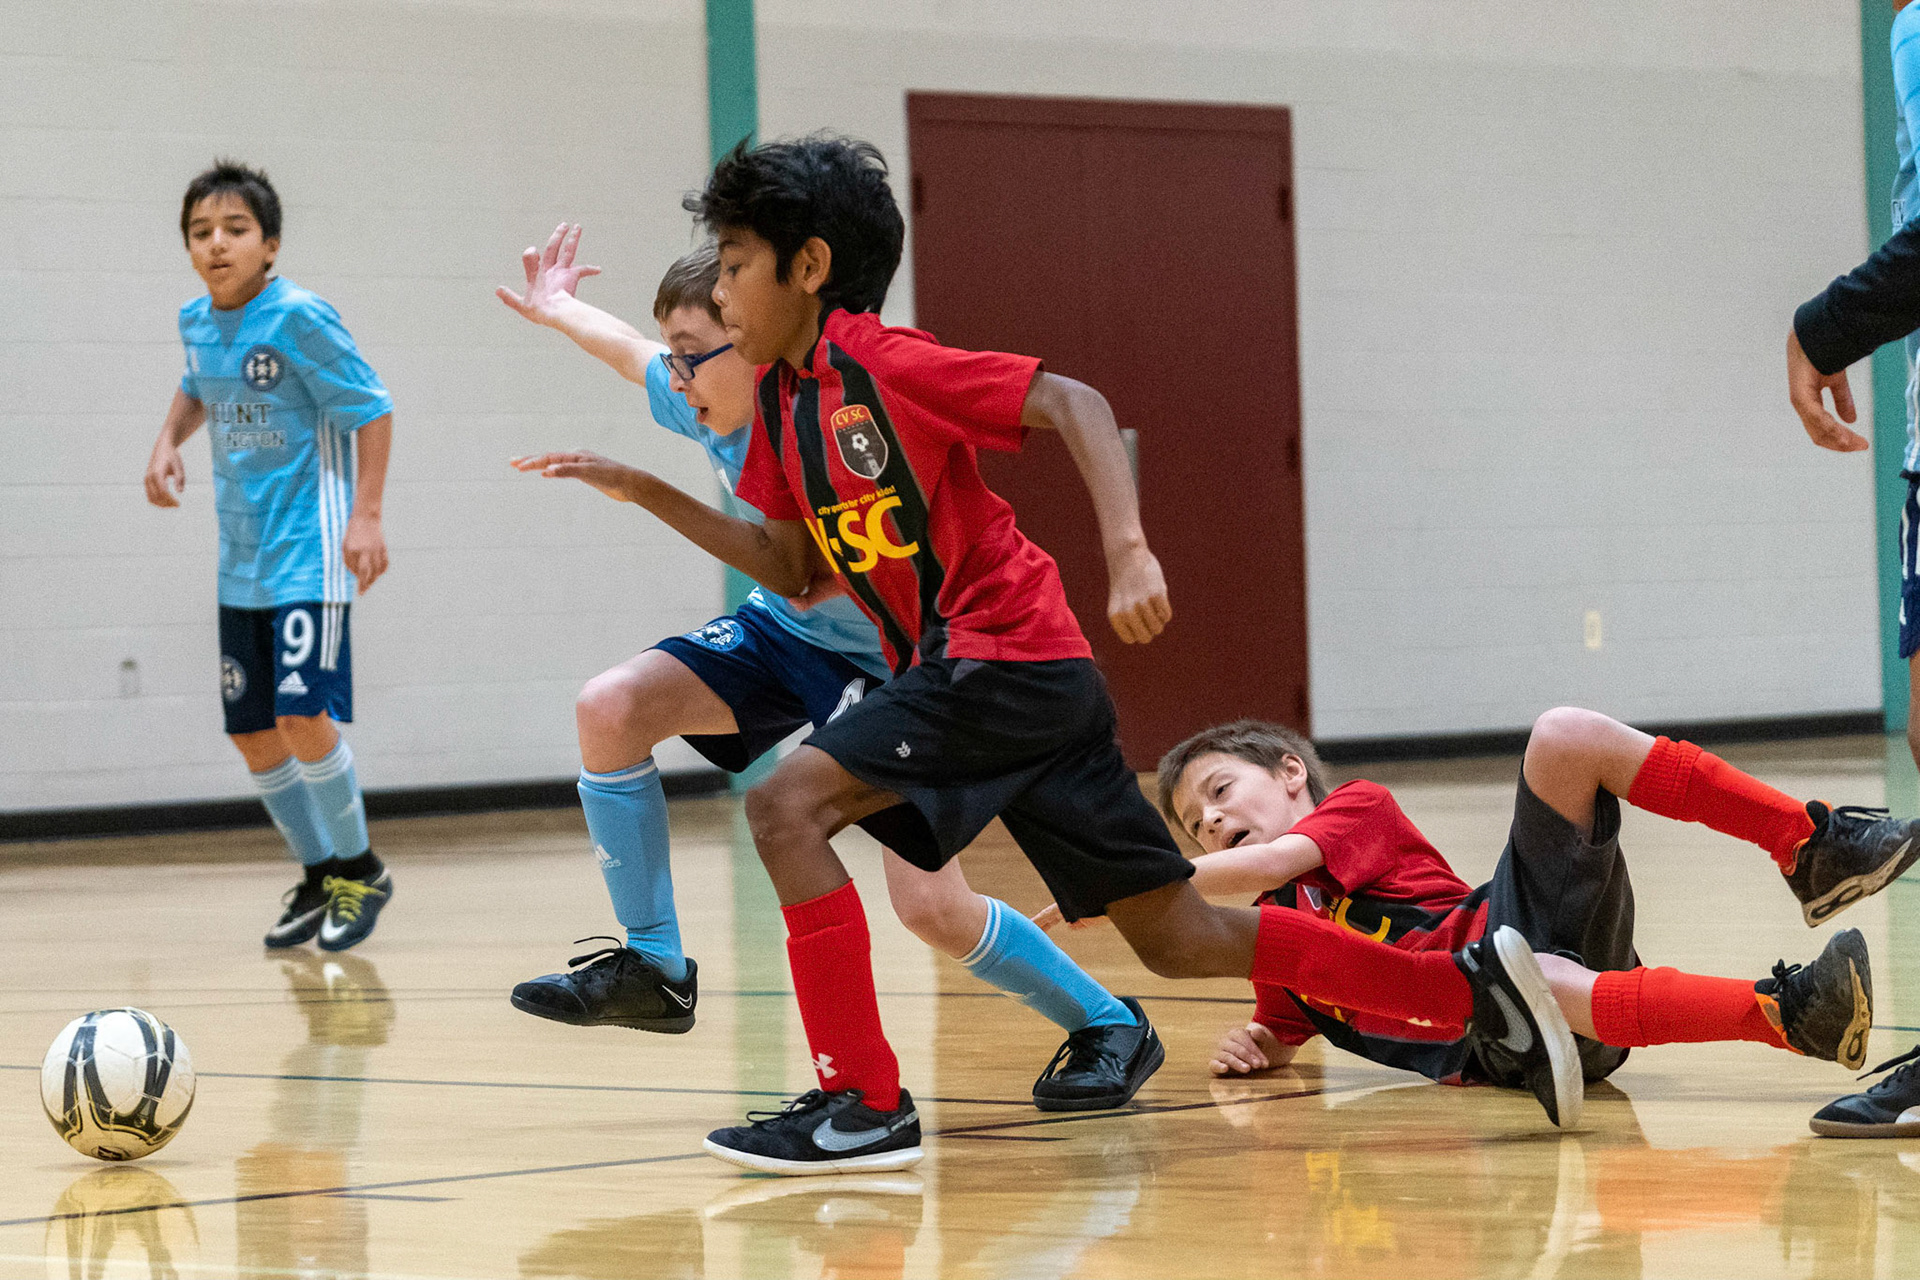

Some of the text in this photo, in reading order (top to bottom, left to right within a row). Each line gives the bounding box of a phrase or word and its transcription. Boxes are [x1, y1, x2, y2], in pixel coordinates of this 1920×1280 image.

[835, 407, 865, 425] CV SC
[859, 492, 876, 505] city
[282, 608, 316, 668] 9
